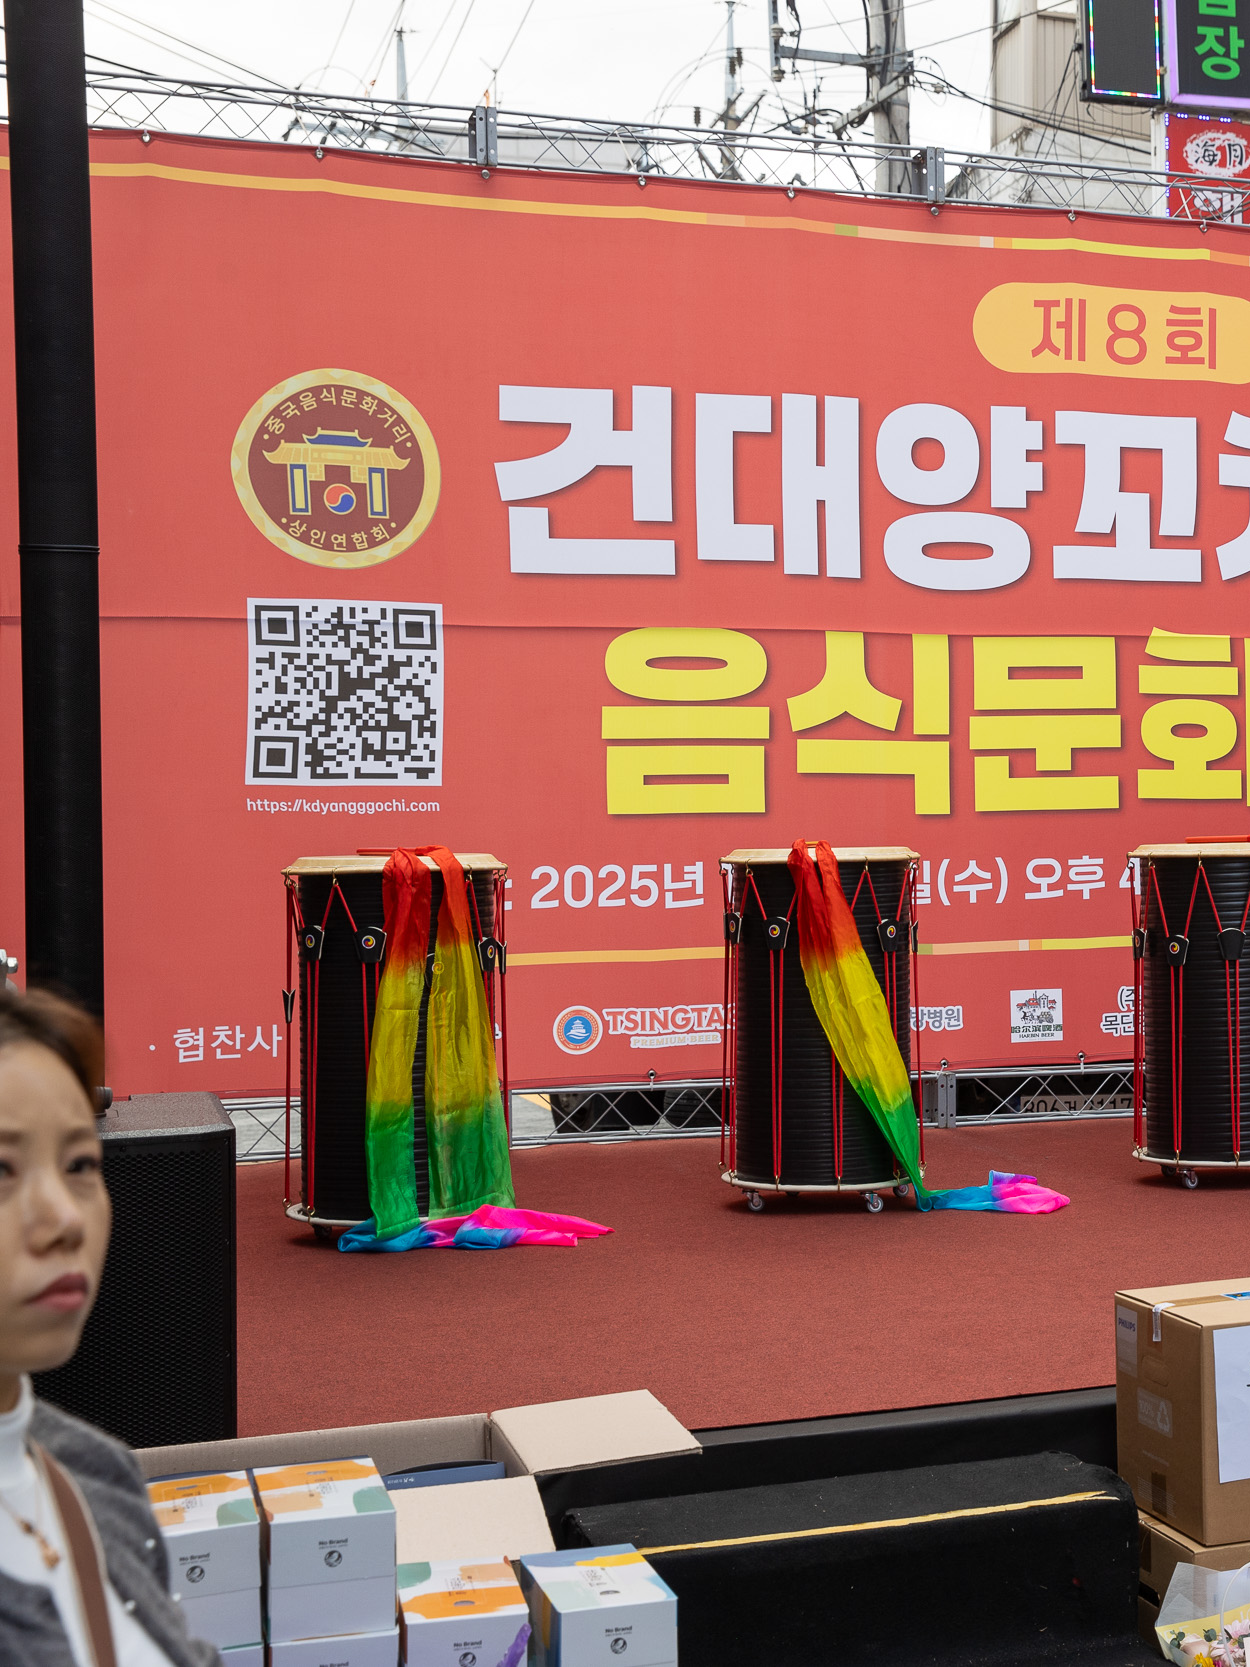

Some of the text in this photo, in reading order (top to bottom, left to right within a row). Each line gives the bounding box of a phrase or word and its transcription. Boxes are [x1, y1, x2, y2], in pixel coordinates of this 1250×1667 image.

[1194, 0, 1245, 80] 장
[1031, 297, 1218, 370] 제8회
[264, 387, 412, 443] 중국음식문화거리
[289, 520, 390, 550] 상인연합회
[246, 798, 440, 814] https://kdyangggochi.com
[530, 861, 705, 909] 2025년
[1024, 855, 1106, 900] 오후
[173, 1024, 282, 1063] 협찬사
[633, 1034, 720, 1046] PREMIUM BEER
[1118, 1317, 1136, 1332] PHILIPS
